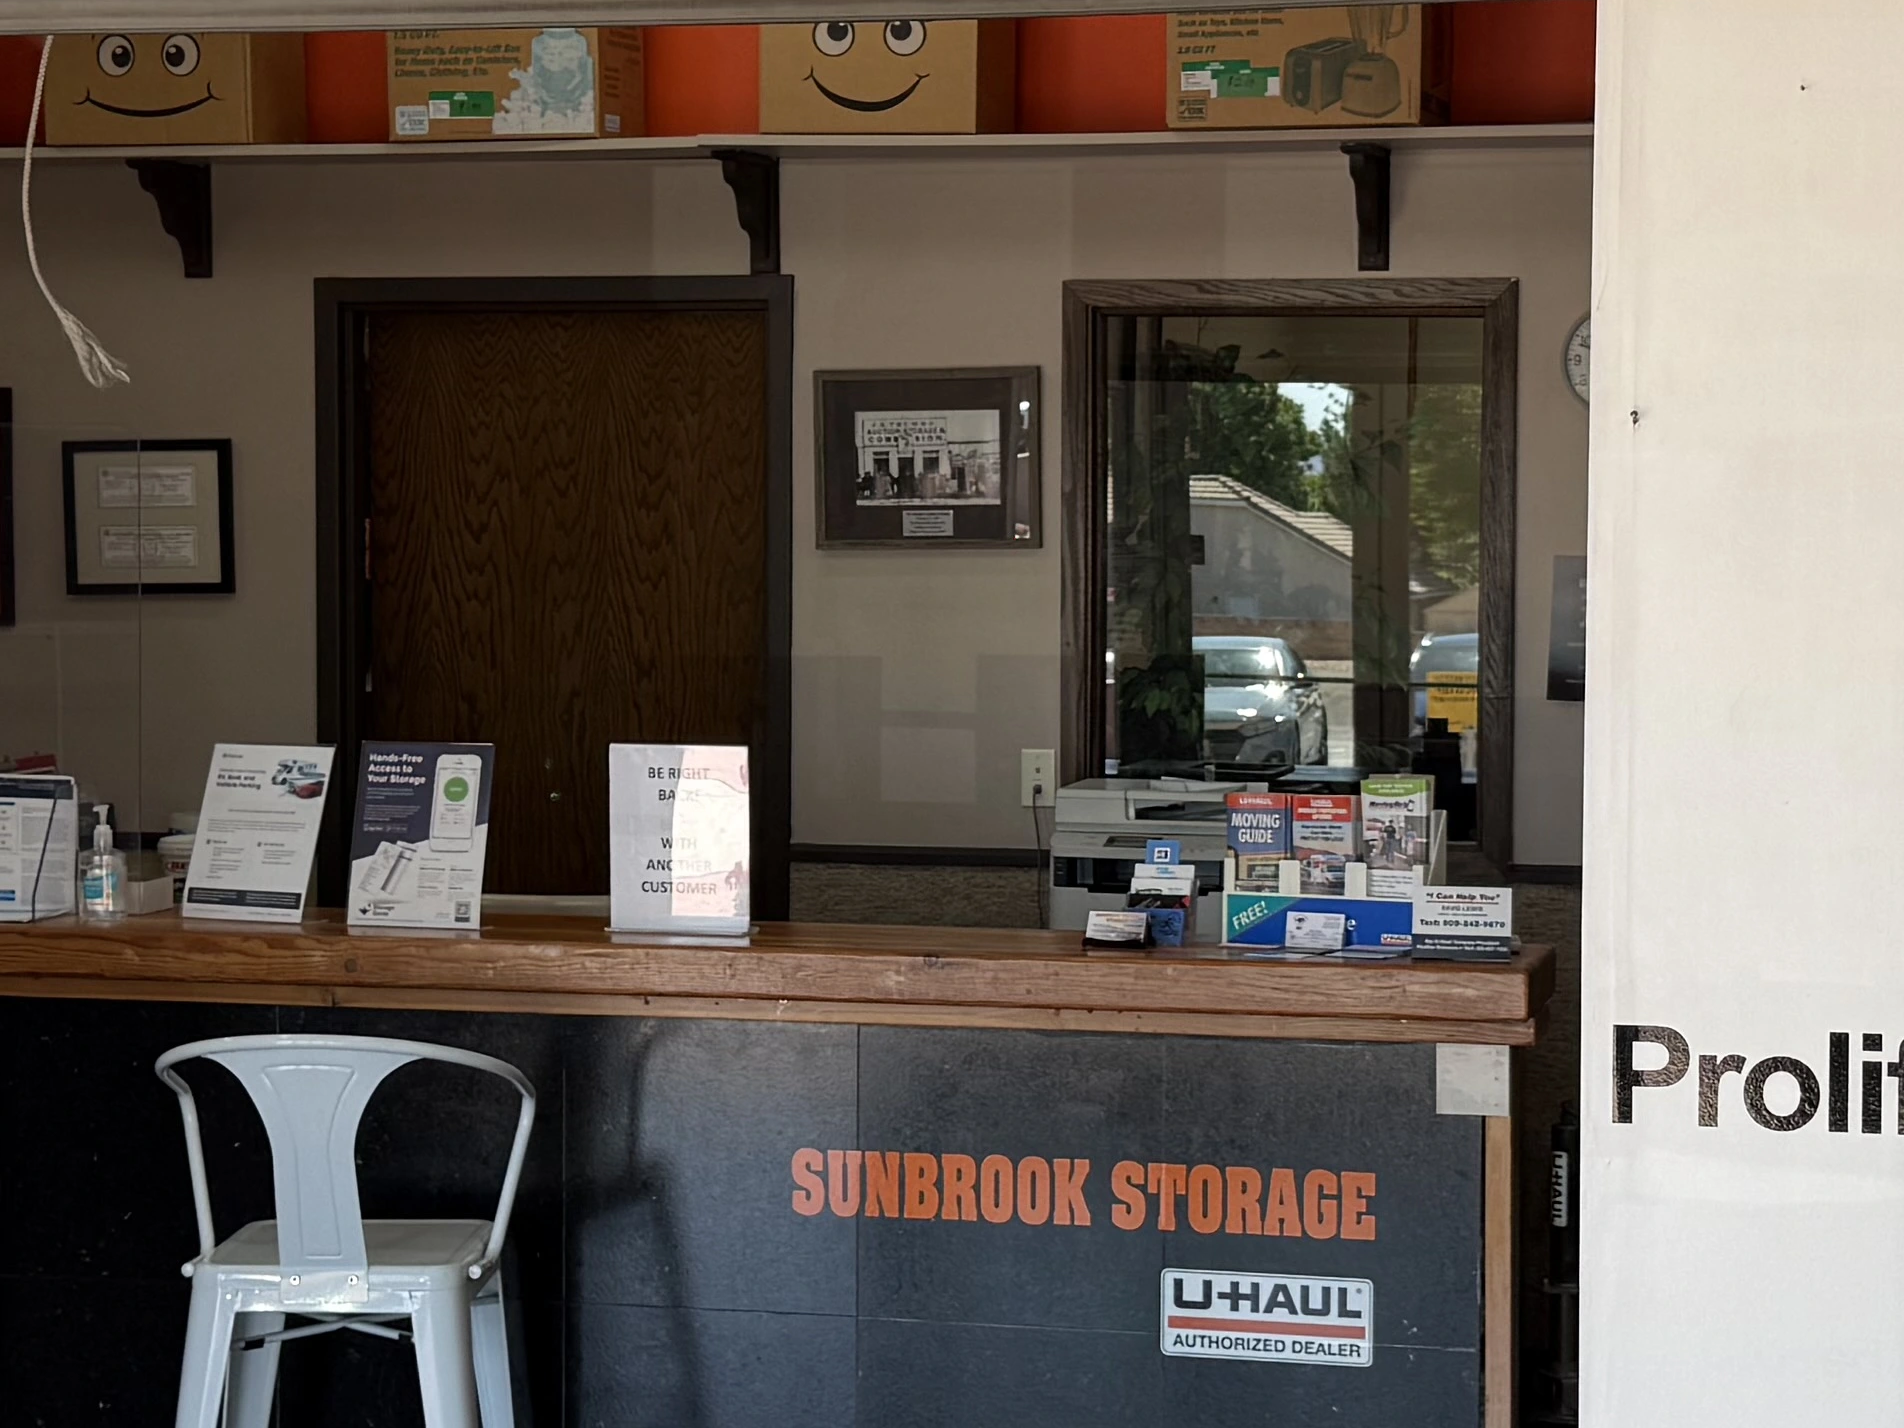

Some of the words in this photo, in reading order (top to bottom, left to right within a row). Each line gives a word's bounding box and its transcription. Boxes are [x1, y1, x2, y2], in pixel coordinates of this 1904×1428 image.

[368, 752, 424, 764] Hands-Free
[367, 763, 401, 773] Access
[402, 764, 414, 773] to
[647, 766, 665, 780] BE
[668, 766, 711, 781] RIGHT
[367, 775, 389, 784] Your
[390, 775, 427, 786] Storage
[1230, 812, 1281, 829] MOVING
[1237, 828, 1275, 844] GUIDE
[641, 880, 718, 896] CUSTOMER
[1436, 892, 1454, 900] Can
[1456, 893, 1477, 901] Help
[1231, 900, 1269, 931] FREE!
[791, 1147, 1092, 1227] SUNBROOK
[1111, 1159, 1377, 1241] STORAGE
[1172, 1277, 1362, 1319] U-HAUL
[1173, 1332, 1287, 1355] AUTHORIZED
[1292, 1337, 1361, 1358] DEALER
